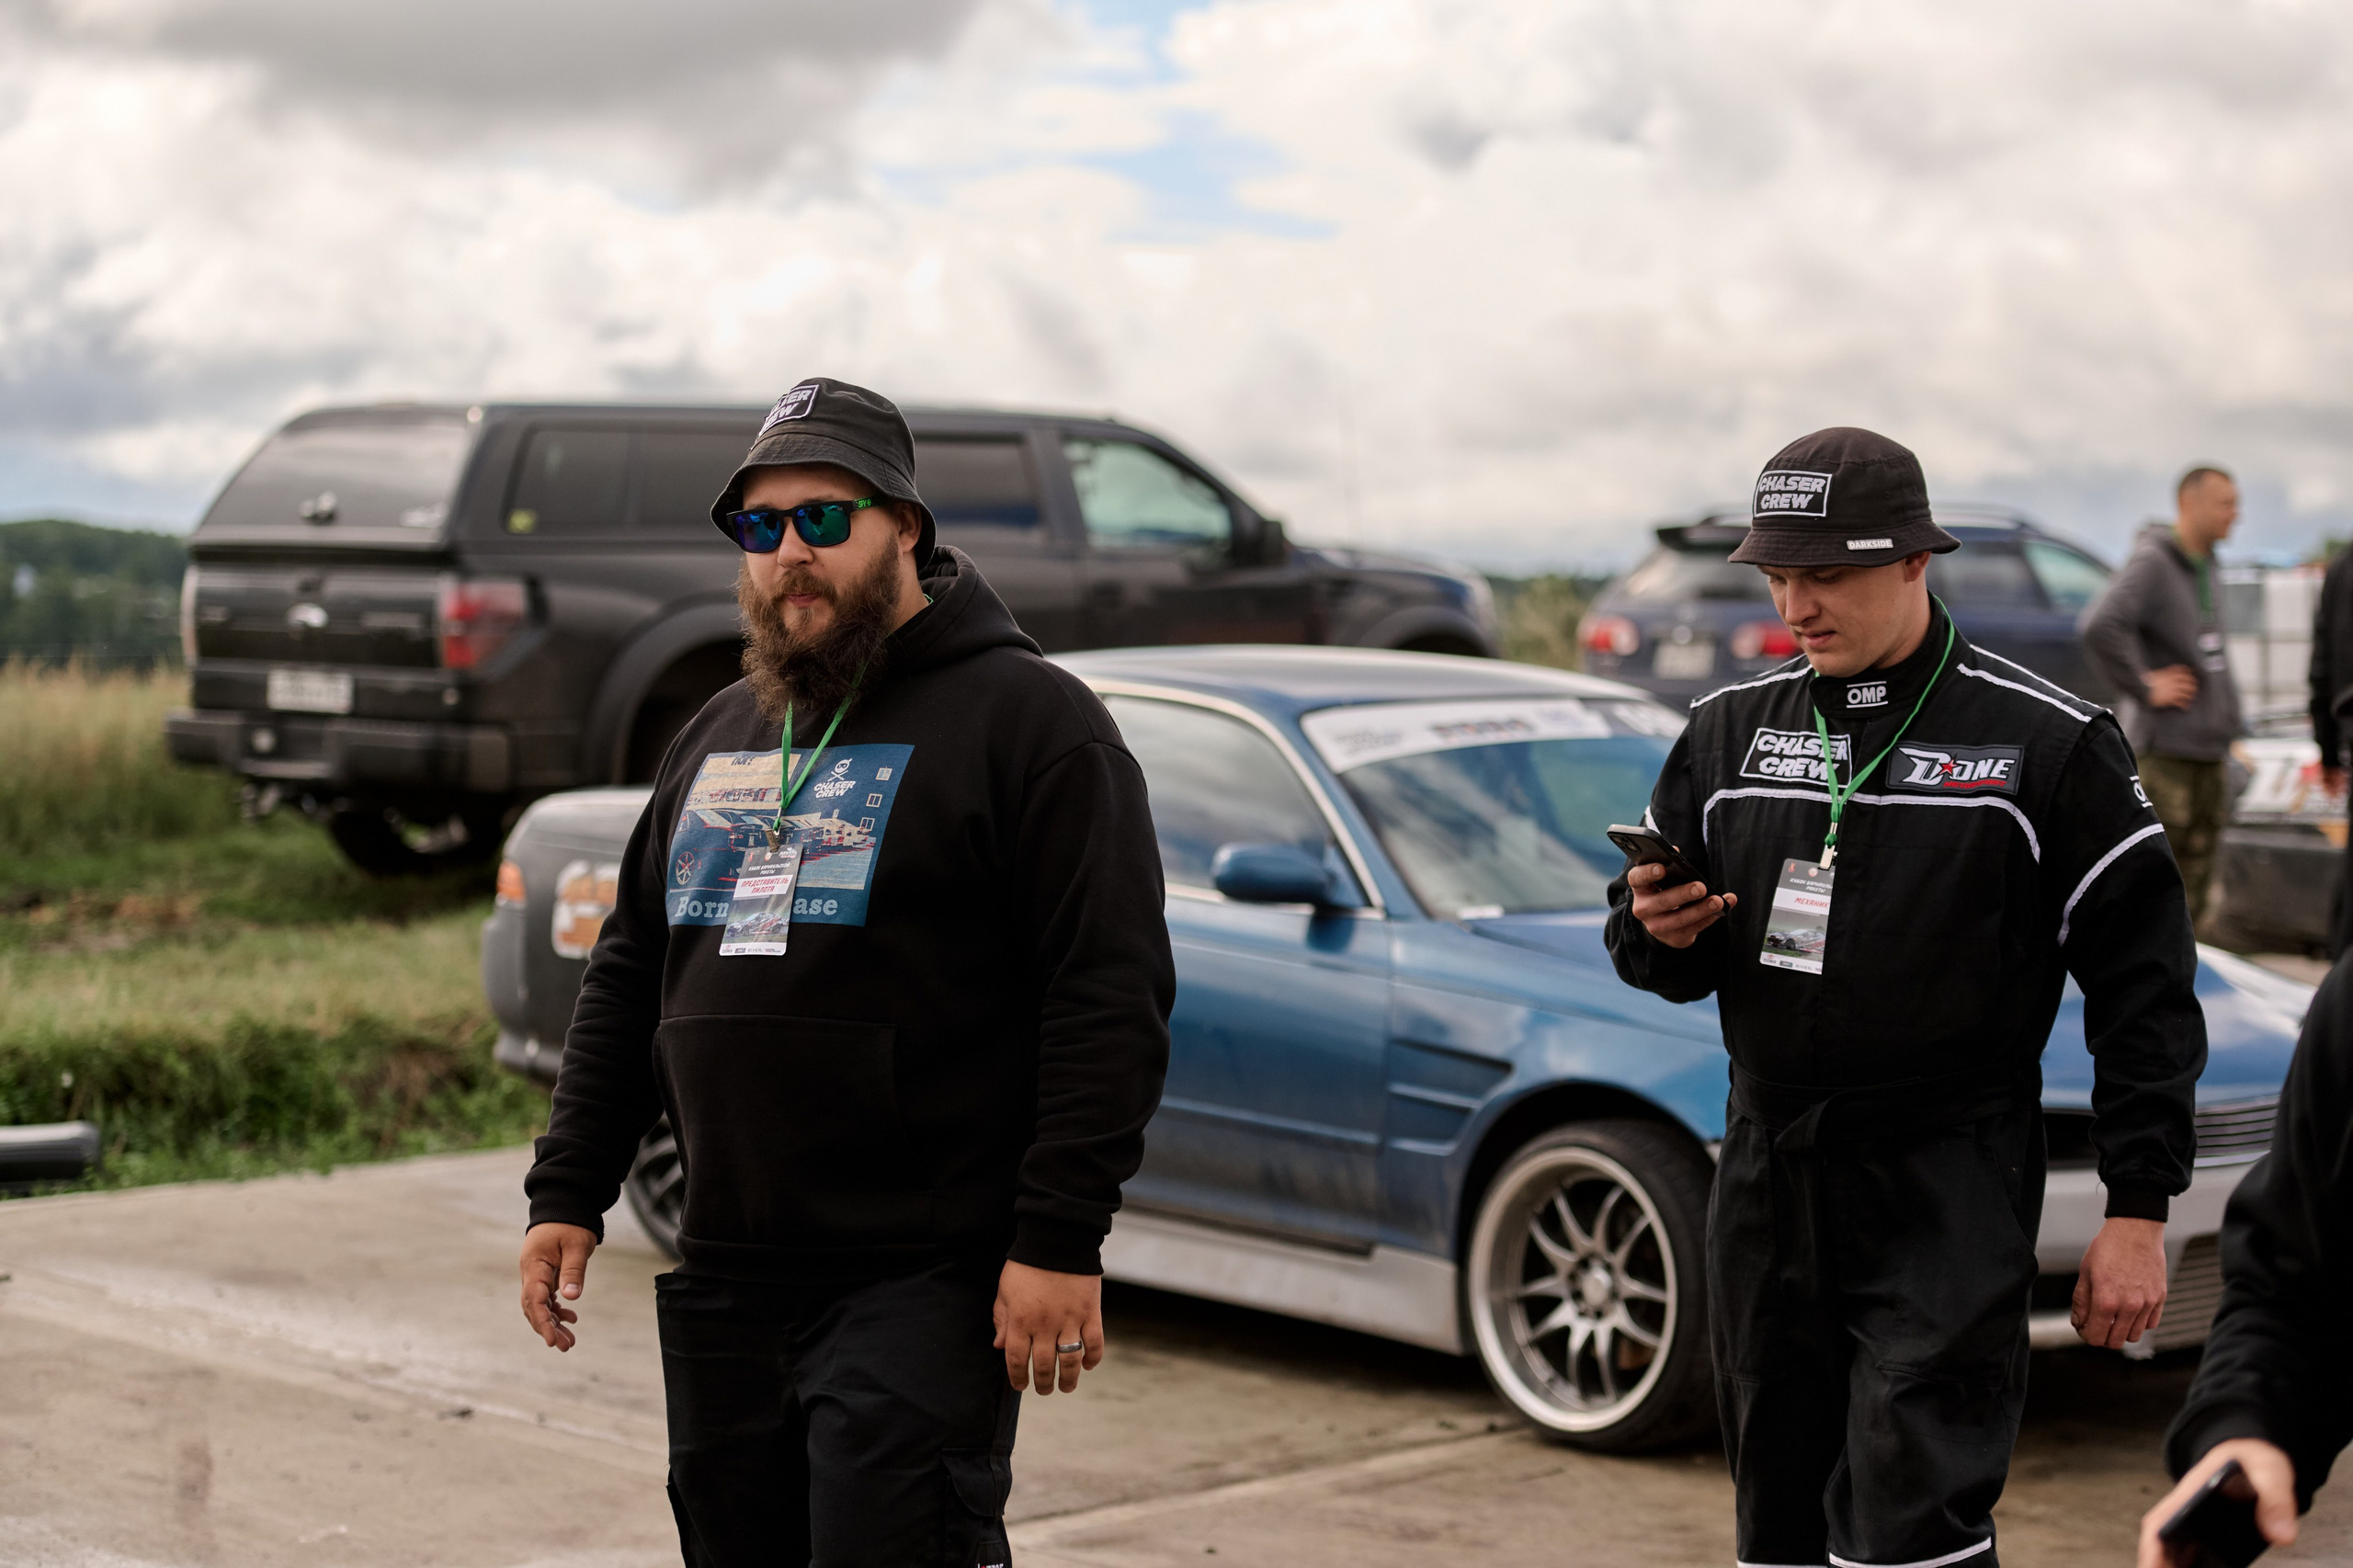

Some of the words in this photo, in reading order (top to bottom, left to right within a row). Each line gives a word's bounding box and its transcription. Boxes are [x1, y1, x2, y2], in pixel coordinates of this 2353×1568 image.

[1759, 475, 1826, 493] CHASER
[1760, 494, 1814, 509] CREW
[1848, 539, 1893, 550] DARKSIDE
[1847, 686, 1886, 704] OMP
[1756, 734, 1847, 760] CHASER
[1759, 756, 1840, 780] CREW
[814, 781, 856, 790] CHASER
[1943, 779, 2007, 789] MOTORSPORT
[815, 789, 847, 798] CREW
[741, 877, 790, 888] ПРЕДСТАВИТЕЛЬ
[751, 885, 776, 894] ПИЛОТА
[675, 896, 729, 918] Born
[1794, 897, 1829, 908] МЕХАНИК
